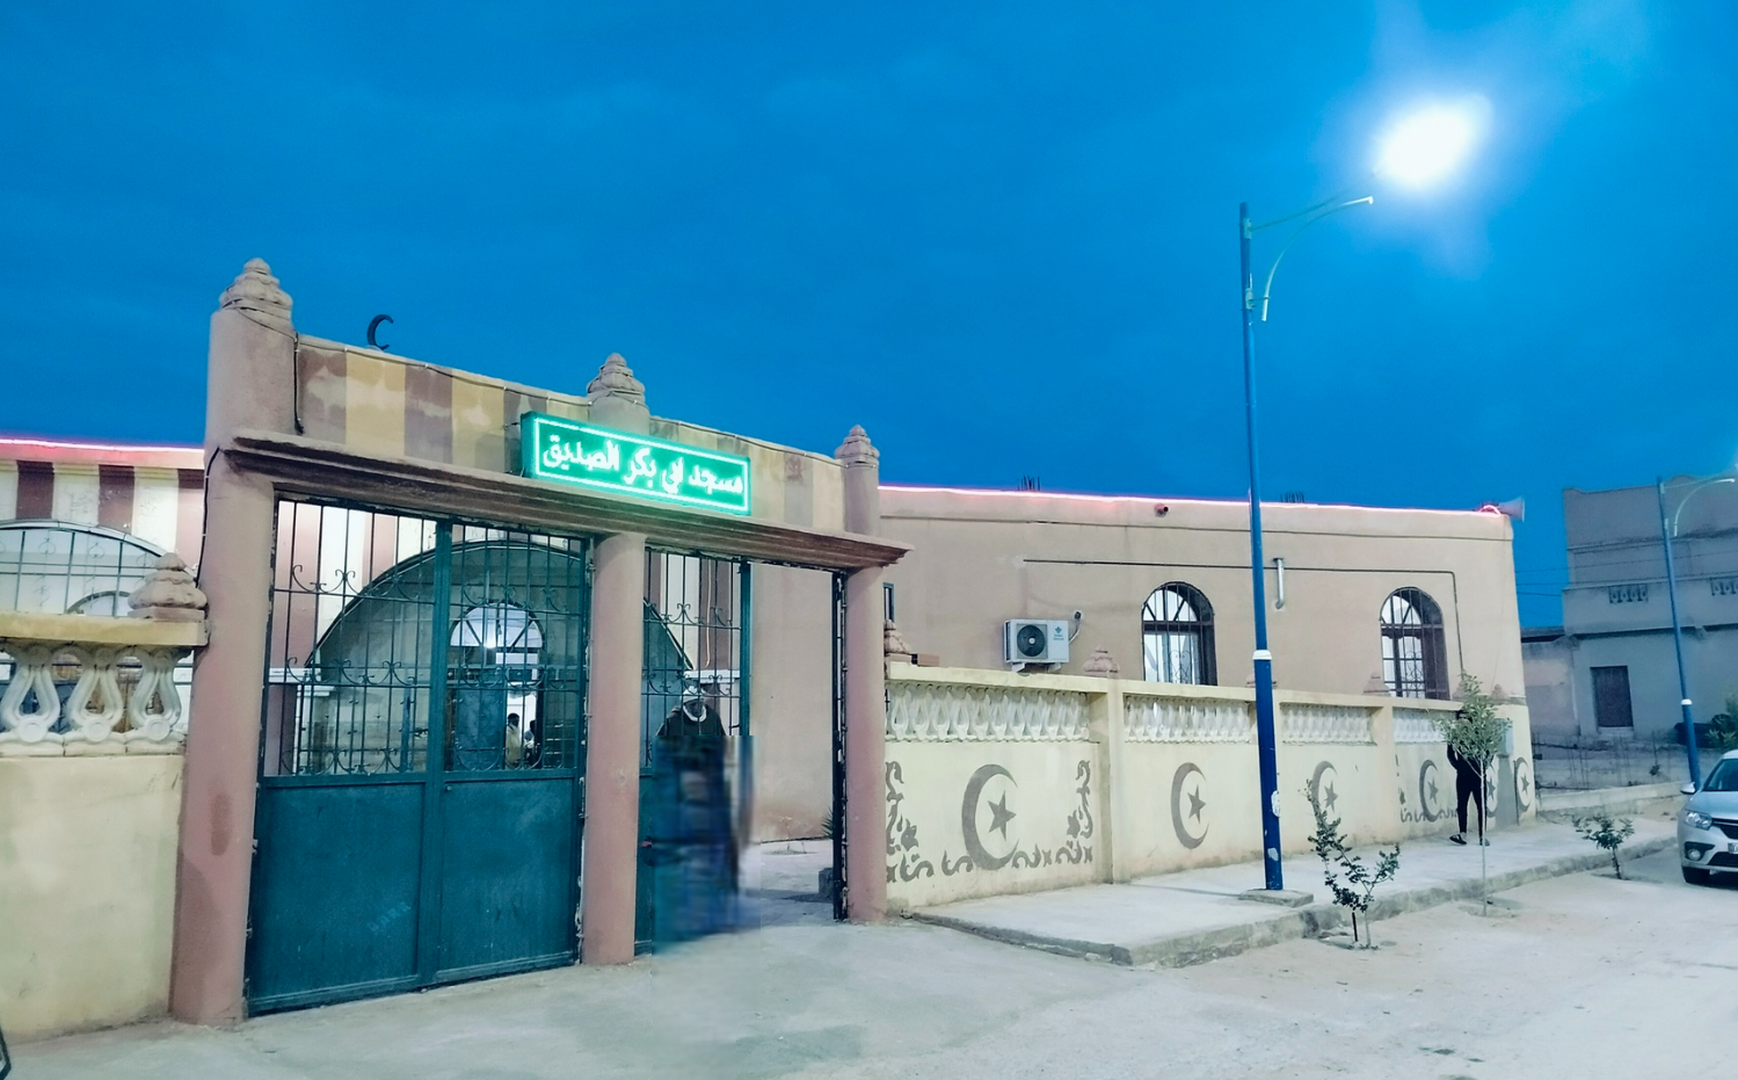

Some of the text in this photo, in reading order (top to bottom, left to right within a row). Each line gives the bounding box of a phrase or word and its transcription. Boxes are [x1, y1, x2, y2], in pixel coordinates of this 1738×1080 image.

[543, 434, 620, 472] الصديق
[623, 447, 657, 488] بكر
[688, 465, 743, 494] مسجد
